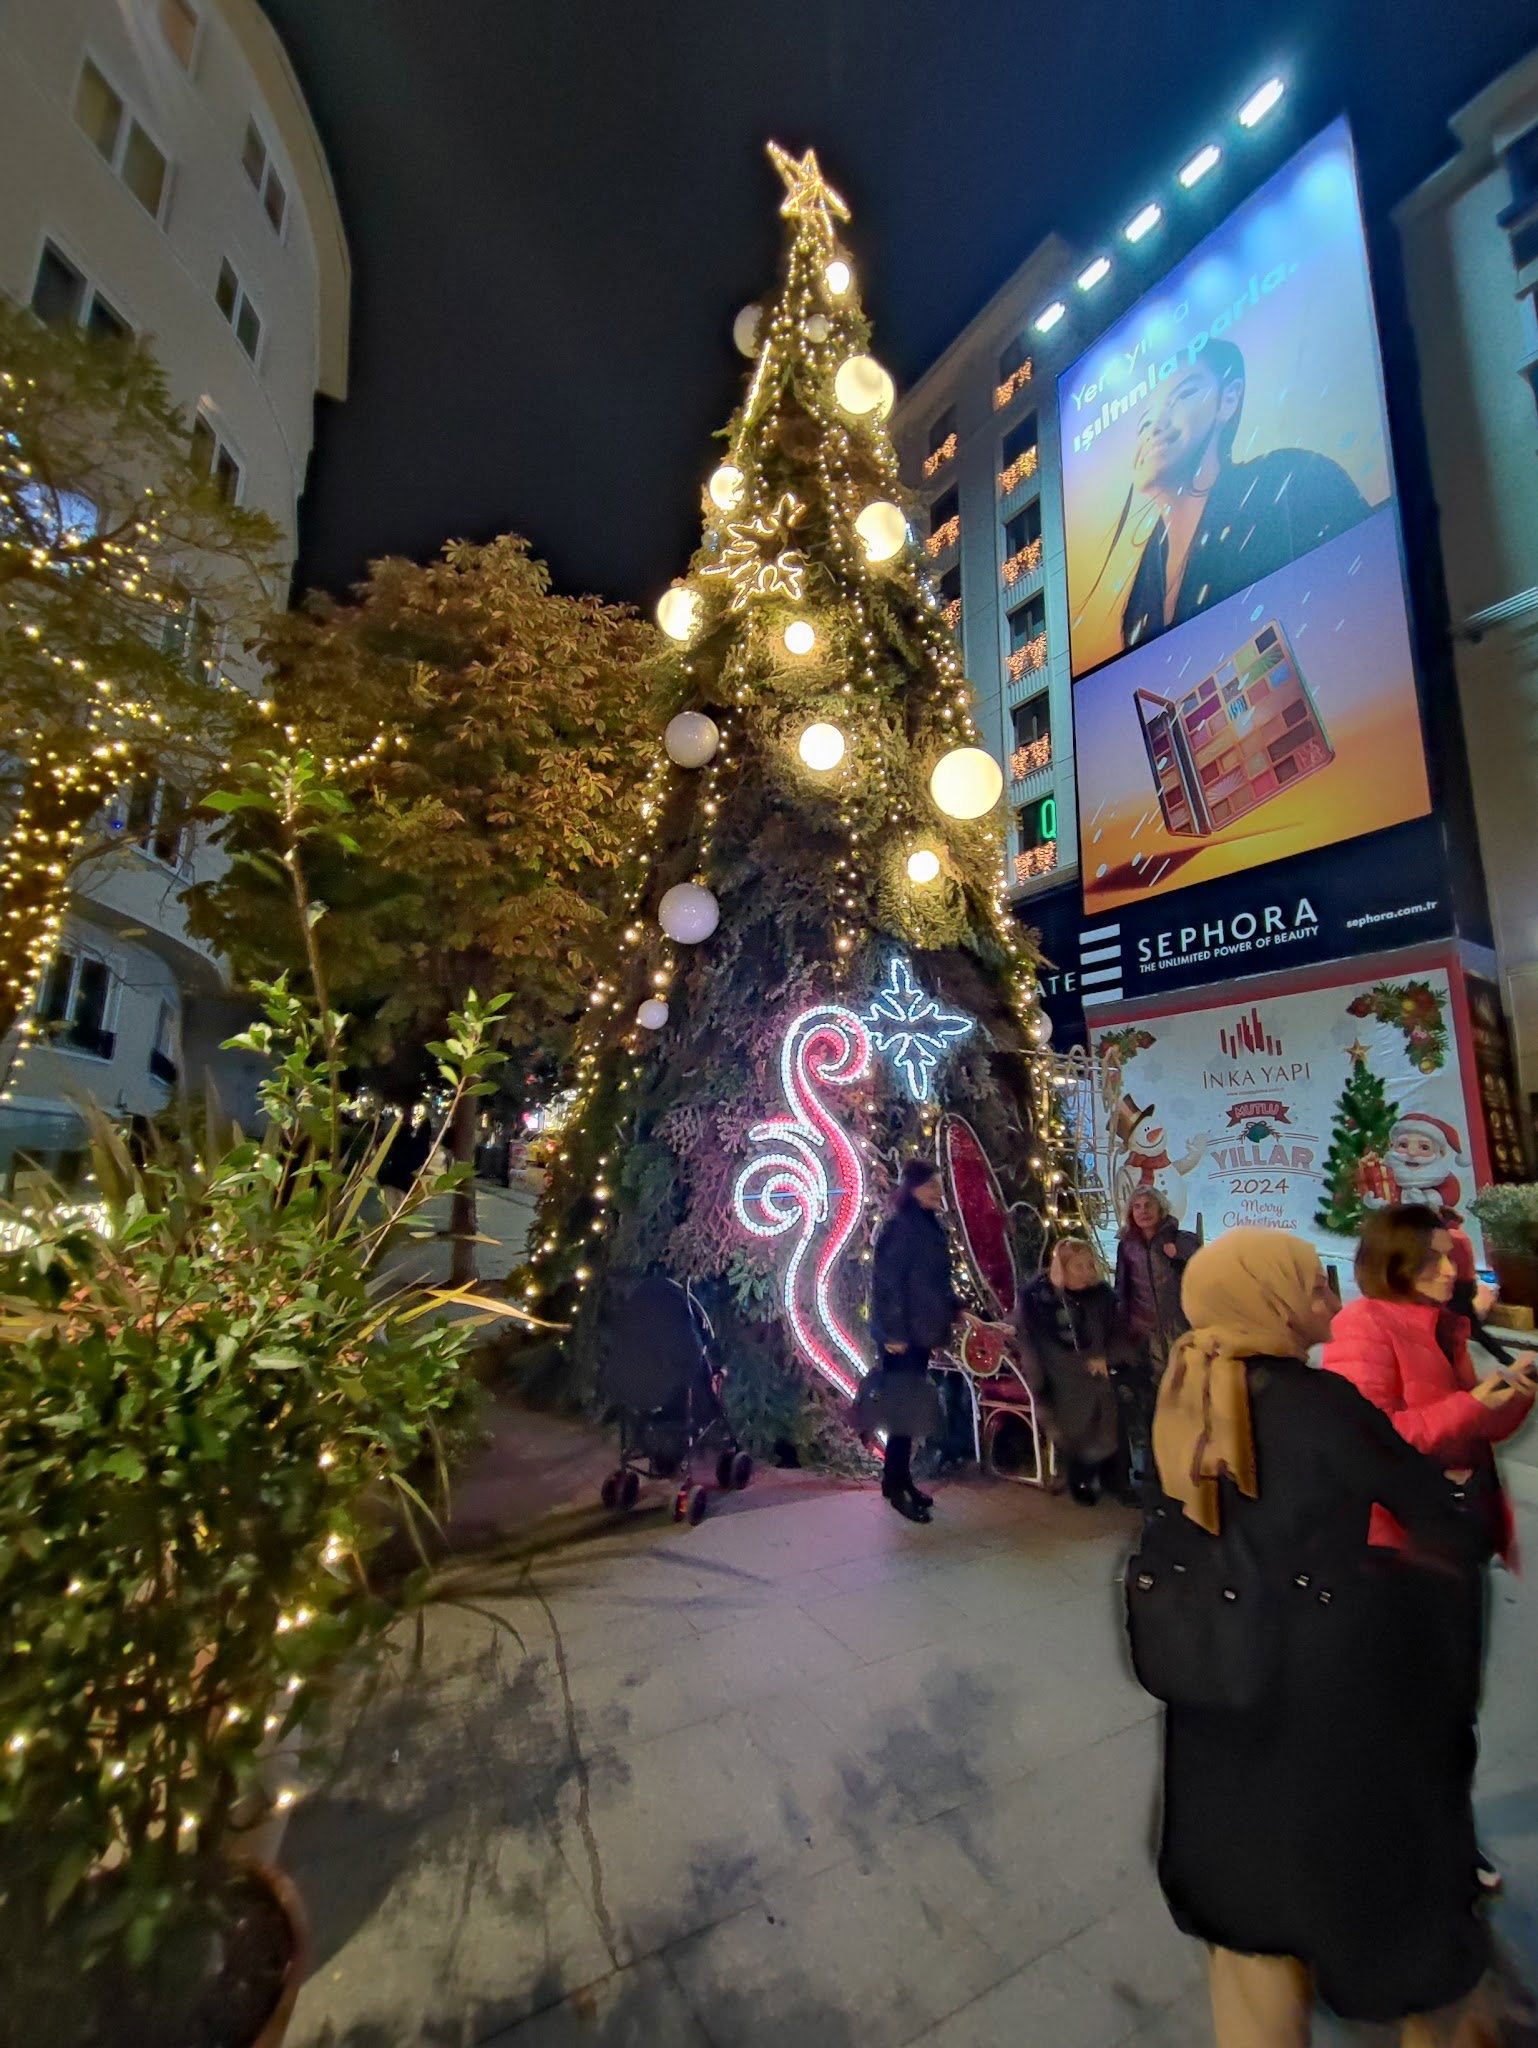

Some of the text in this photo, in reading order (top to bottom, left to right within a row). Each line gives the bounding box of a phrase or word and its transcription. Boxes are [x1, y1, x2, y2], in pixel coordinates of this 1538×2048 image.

[1346, 901, 1438, 929] sephora.com.tr
[1138, 898, 1318, 962] SEPHORA
[1139, 925, 1319, 973] THE UNLIMITED POWER OF BEAUTY
[1260, 1062, 1310, 1084] YAPI
[1234, 1102, 1280, 1118] MUTLU
[1210, 1144, 1314, 1171] YILLAR
[1229, 1178, 1290, 1194] 2024
[1241, 1199, 1285, 1217] Merry
[1222, 1211, 1298, 1229] Christmas
